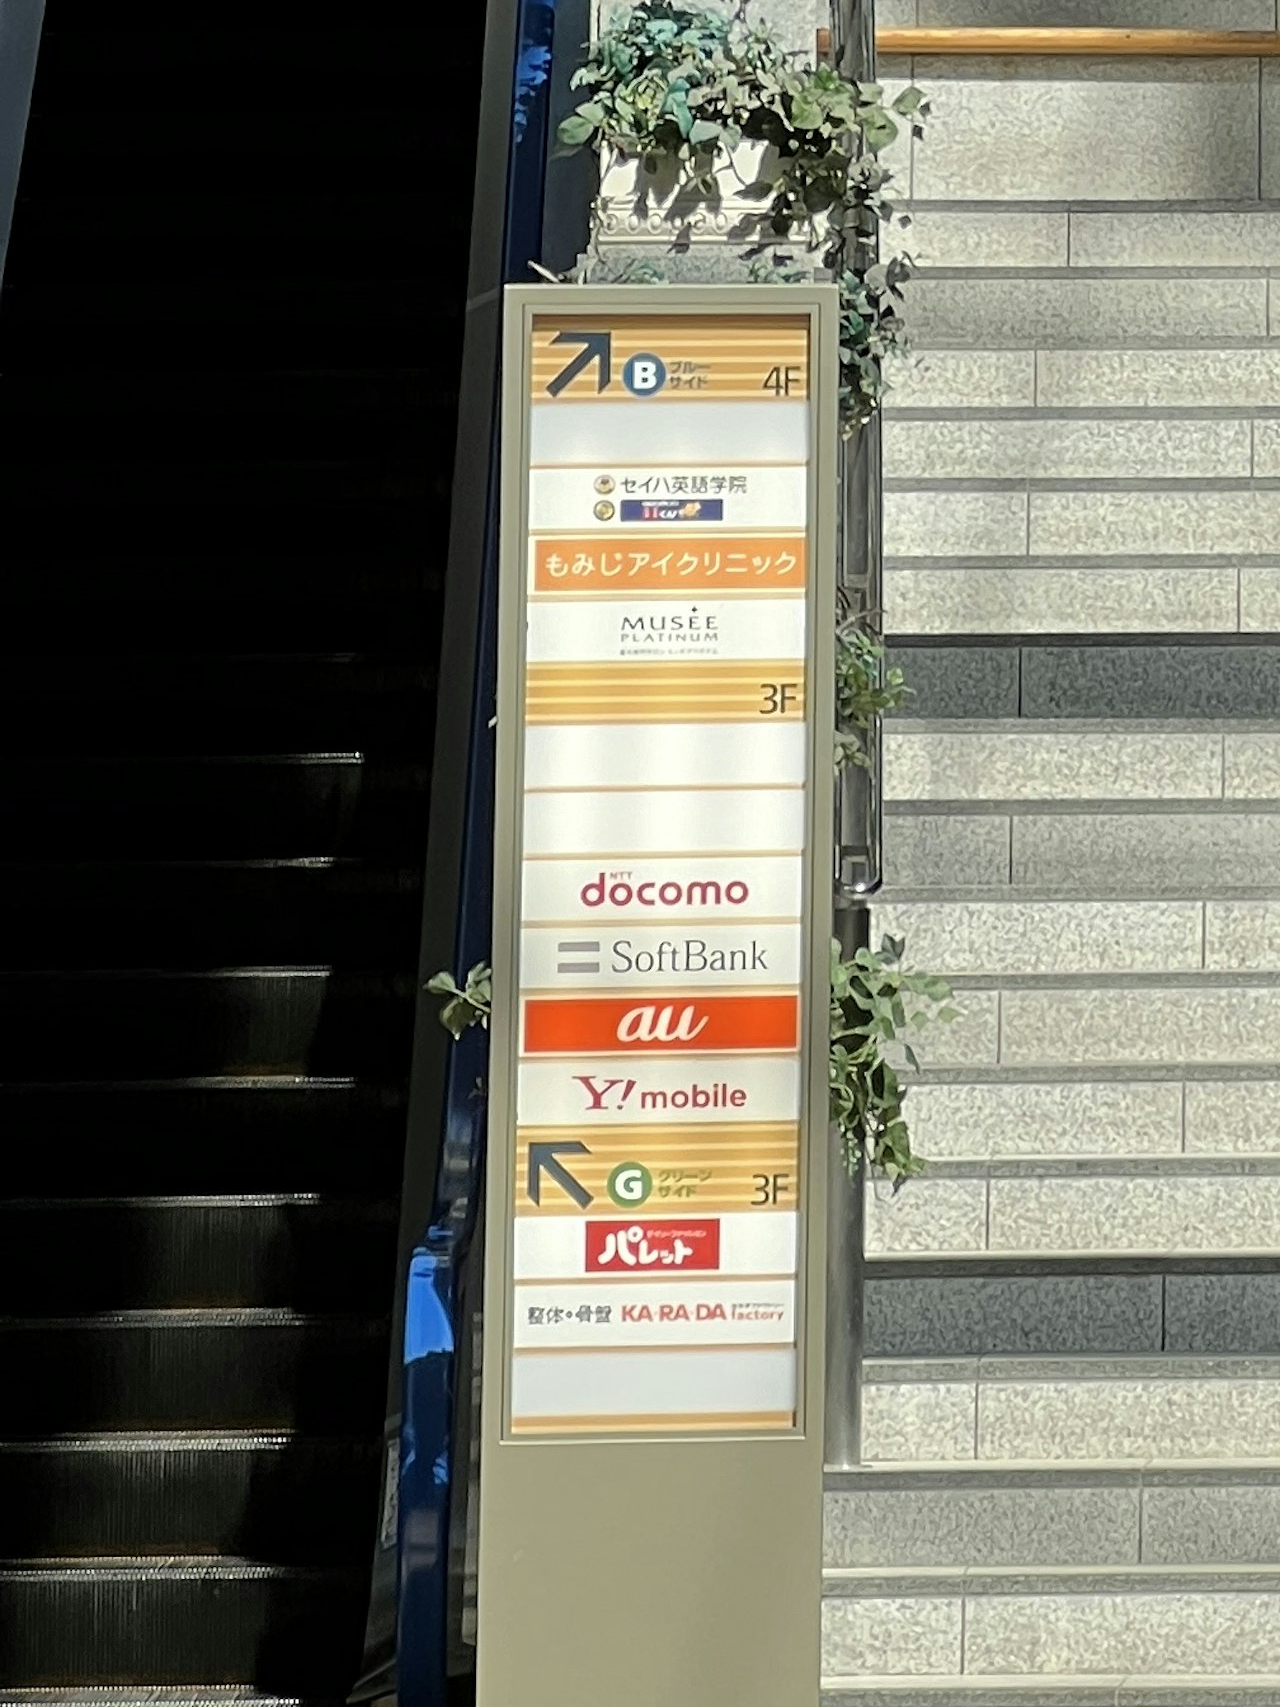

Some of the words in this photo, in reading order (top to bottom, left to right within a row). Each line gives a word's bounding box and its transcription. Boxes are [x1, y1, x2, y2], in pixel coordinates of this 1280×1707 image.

[669, 376, 709, 389] サイド
[670, 361, 711, 374] ブルー
[762, 366, 800, 396] 4F
[620, 476, 747, 495] セイハ英語学院
[545, 550, 797, 577] もみじアイクリニック
[620, 632, 719, 643] PLATINUM
[759, 683, 798, 713] 3F
[580, 872, 749, 907] docomo
[611, 939, 769, 974] SoftBank
[616, 1005, 709, 1043] au
[658, 1169, 712, 1183] グリーン
[750, 1173, 790, 1206] 3F
[597, 1225, 693, 1266] パレット
